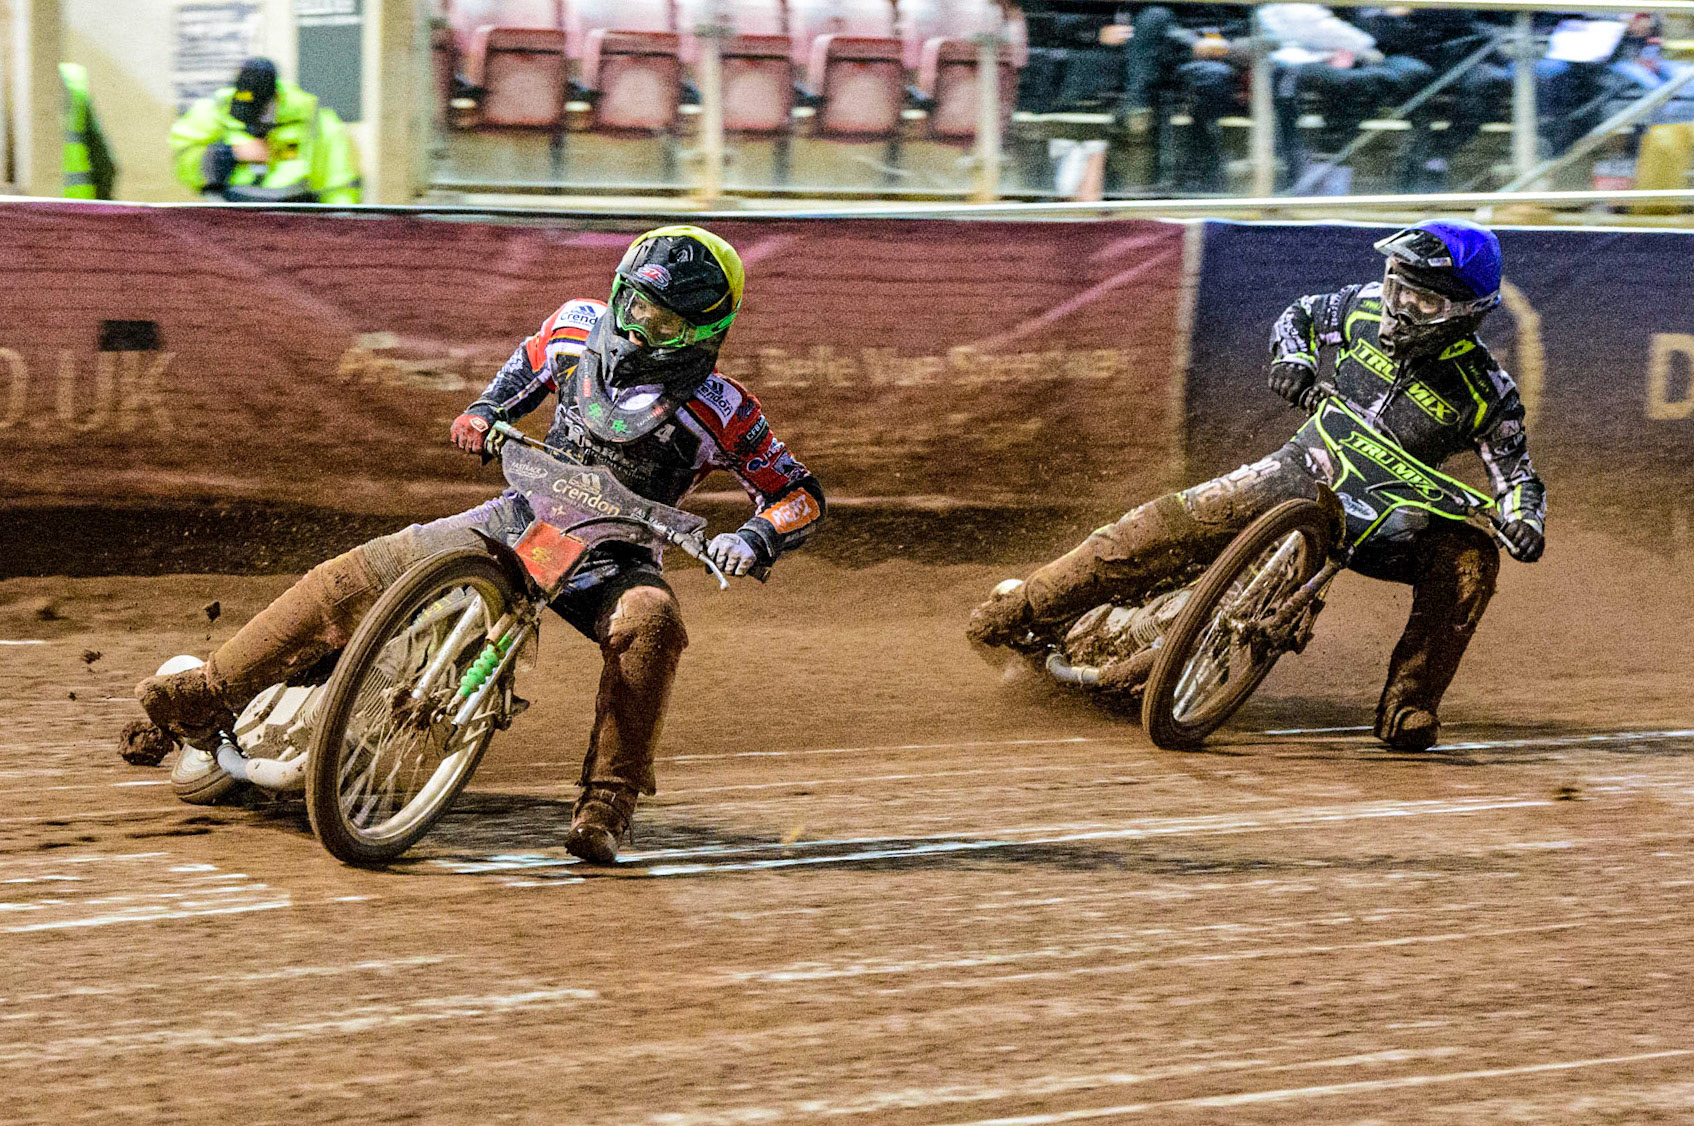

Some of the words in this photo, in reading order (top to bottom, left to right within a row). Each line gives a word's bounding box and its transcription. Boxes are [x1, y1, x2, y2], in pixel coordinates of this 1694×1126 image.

[560, 311, 598, 325] Crend
[697, 382, 734, 417] rendon
[1352, 438, 1396, 465] TRU
[552, 478, 621, 517] Crendon
